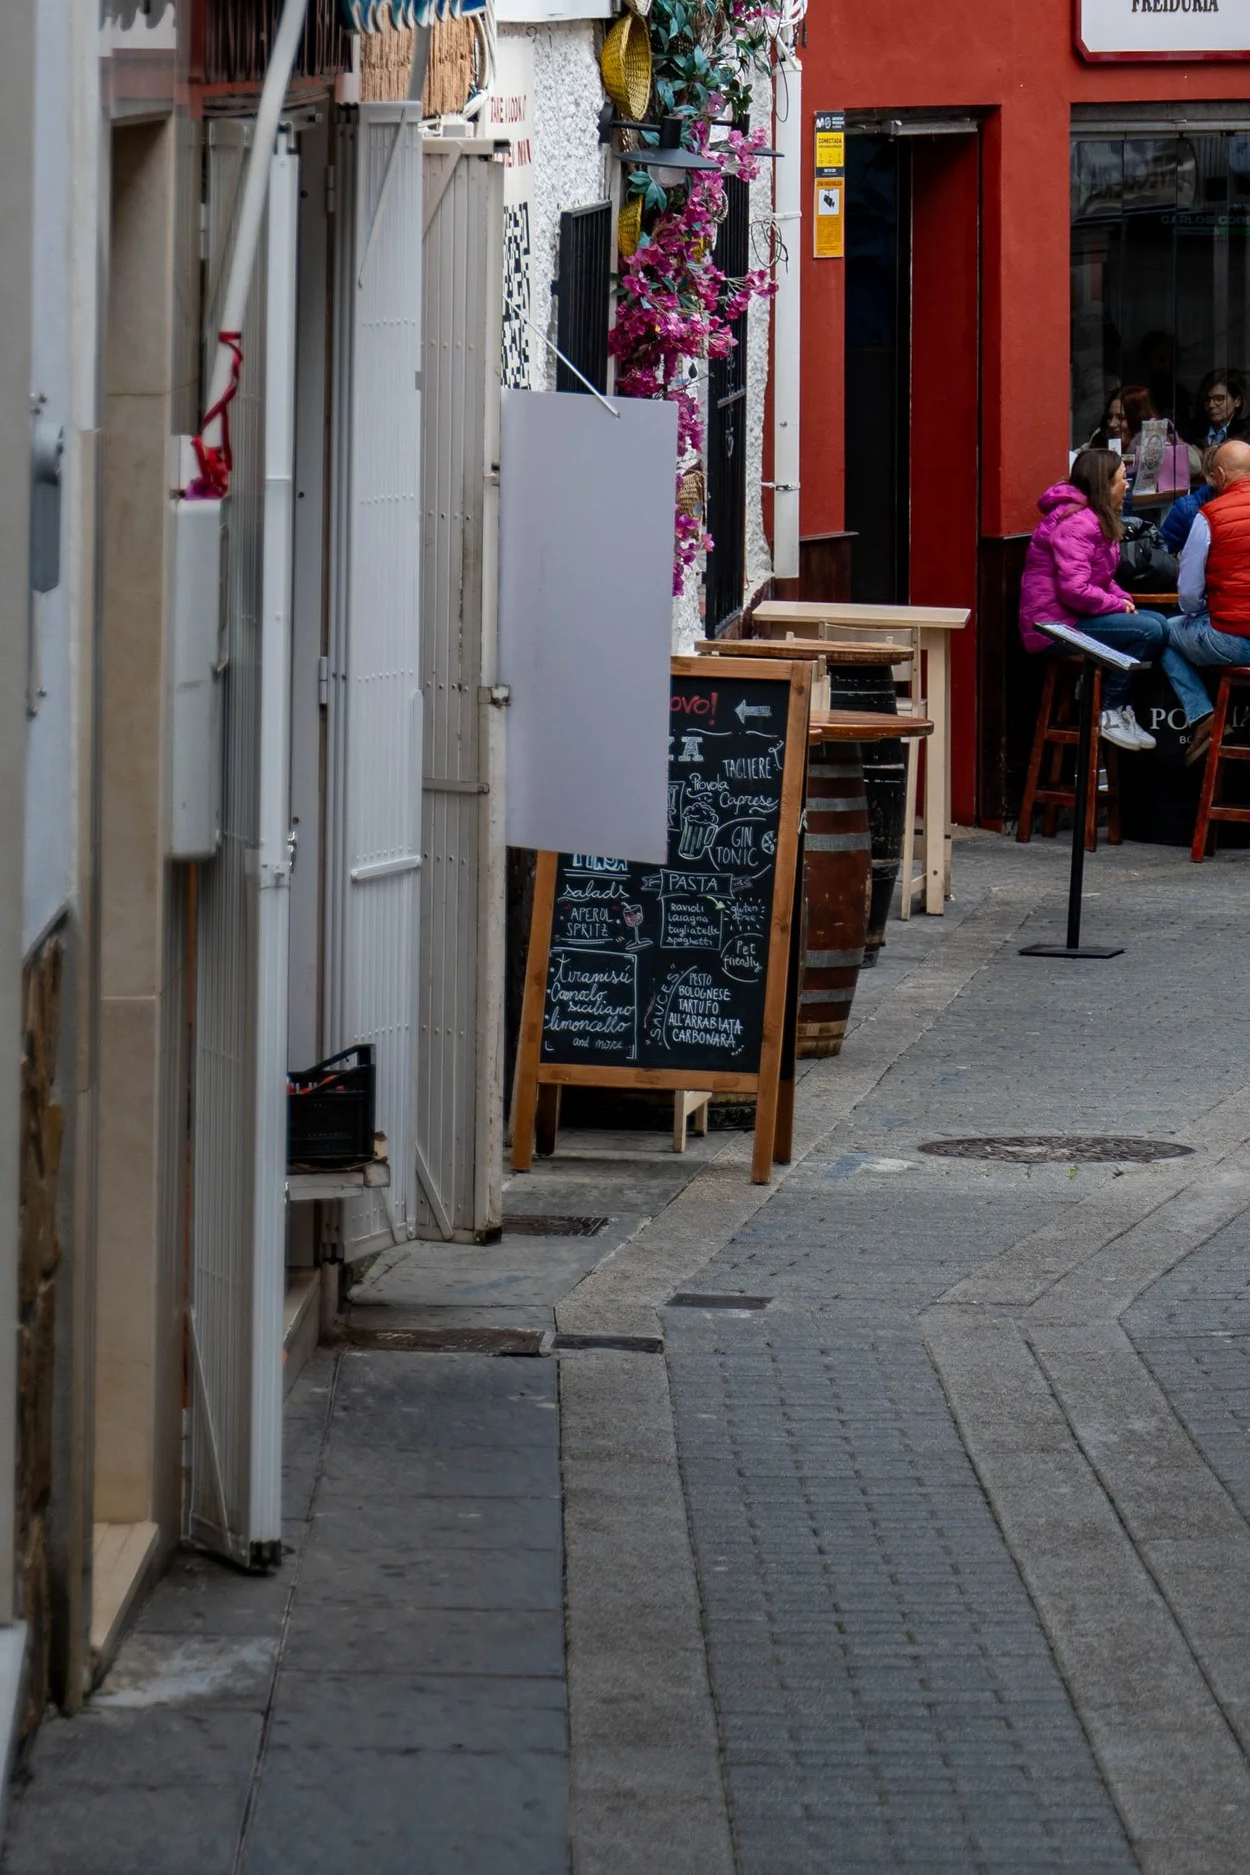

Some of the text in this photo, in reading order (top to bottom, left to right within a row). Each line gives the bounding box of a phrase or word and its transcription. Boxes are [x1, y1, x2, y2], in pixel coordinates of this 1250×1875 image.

[1160, 215, 1215, 225] CARLOS
[670, 692, 718, 725] ovo!
[722, 757, 772, 779] TAGLIERE
[689, 772, 730, 792] Provola
[719, 791, 779, 814] Caprese
[731, 826, 753, 848] GIN
[716, 846, 758, 867] TONIC
[562, 880, 630, 899] salads
[669, 874, 718, 893] PASTA
[570, 907, 613, 923] APEROL
[730, 901, 758, 916] gluten
[566, 922, 609, 939] SPRITZ
[736, 940, 757, 954] Pet
[689, 973, 712, 986] PESTO
[678, 985, 731, 1001] BOLOGNESE
[650, 972, 680, 1041] SAUCES
[678, 998, 719, 1015] TARTUFO
[545, 1006, 631, 1033] limoncello
[573, 1036, 590, 1048] and
[672, 1028, 735, 1048] CARBONARA
